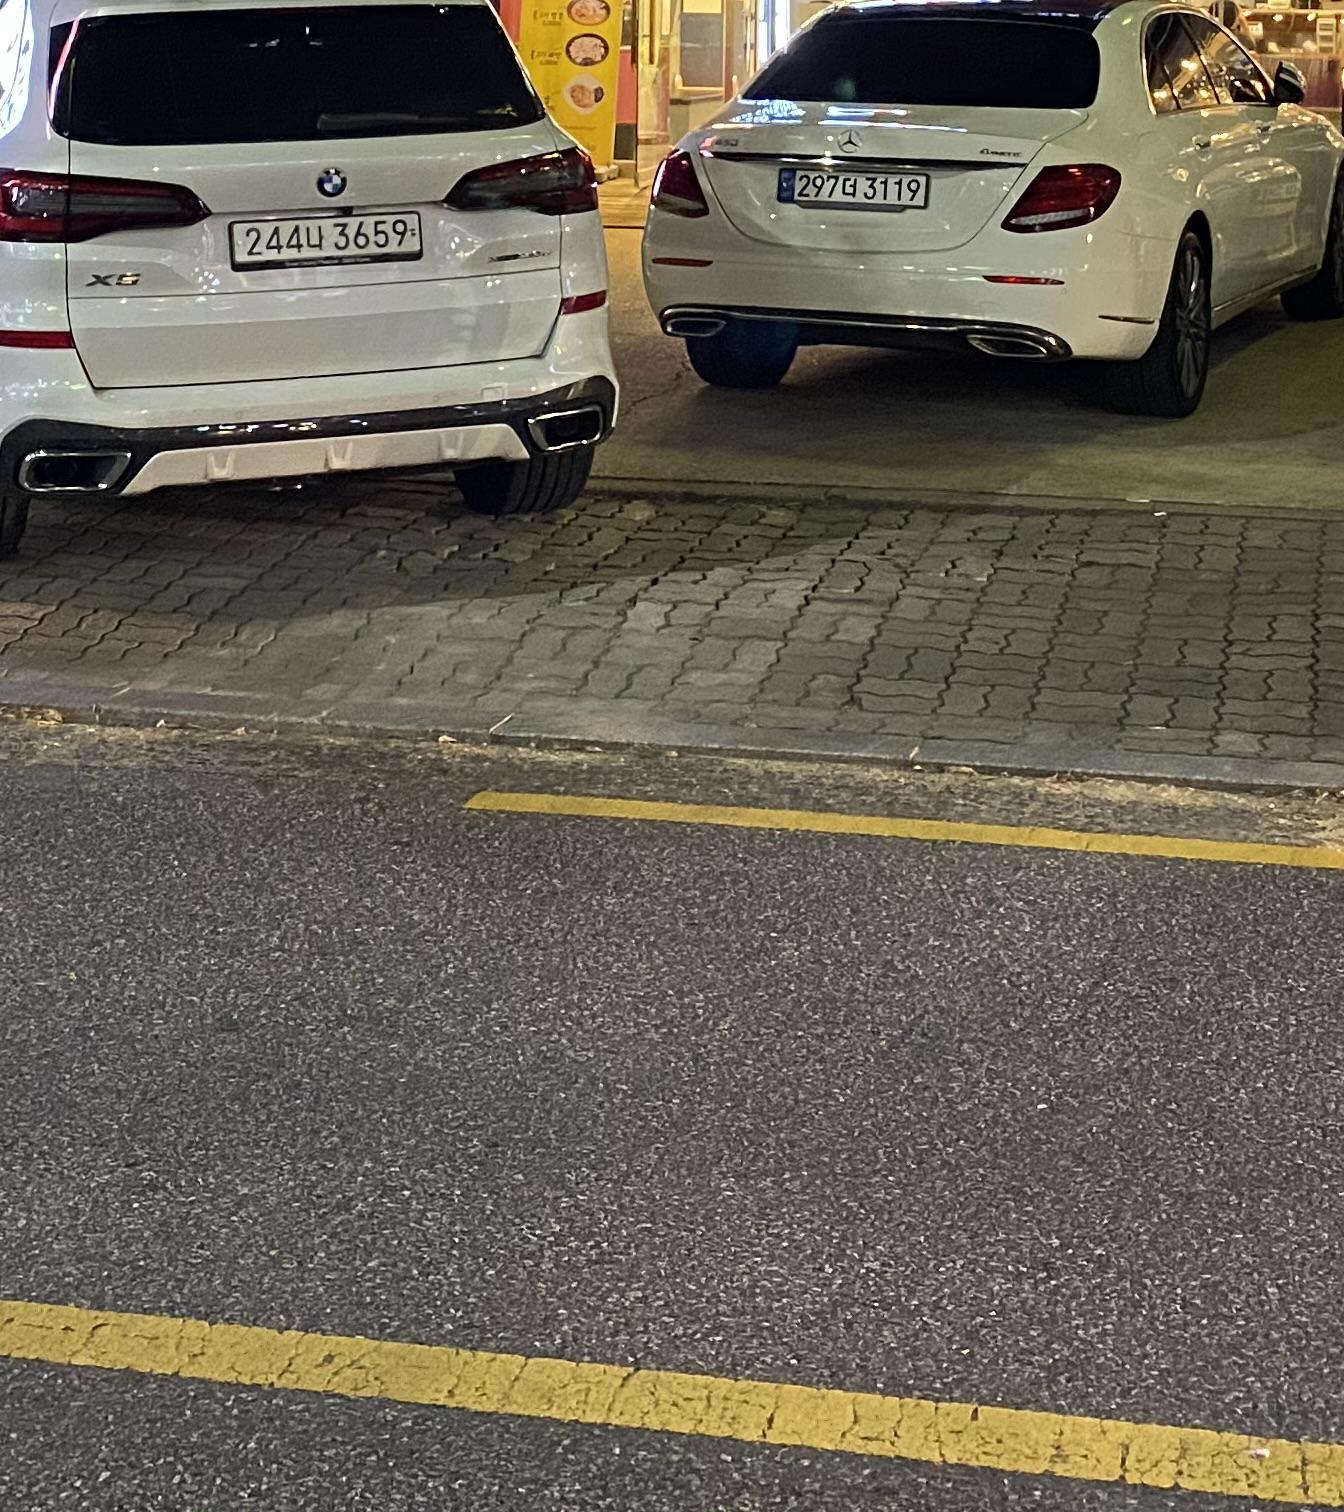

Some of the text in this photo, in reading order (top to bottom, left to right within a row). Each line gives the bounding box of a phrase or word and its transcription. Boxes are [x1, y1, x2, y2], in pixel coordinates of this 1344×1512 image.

[798, 174, 921, 202] 297더 3119
[246, 219, 407, 256] 244나 3659
